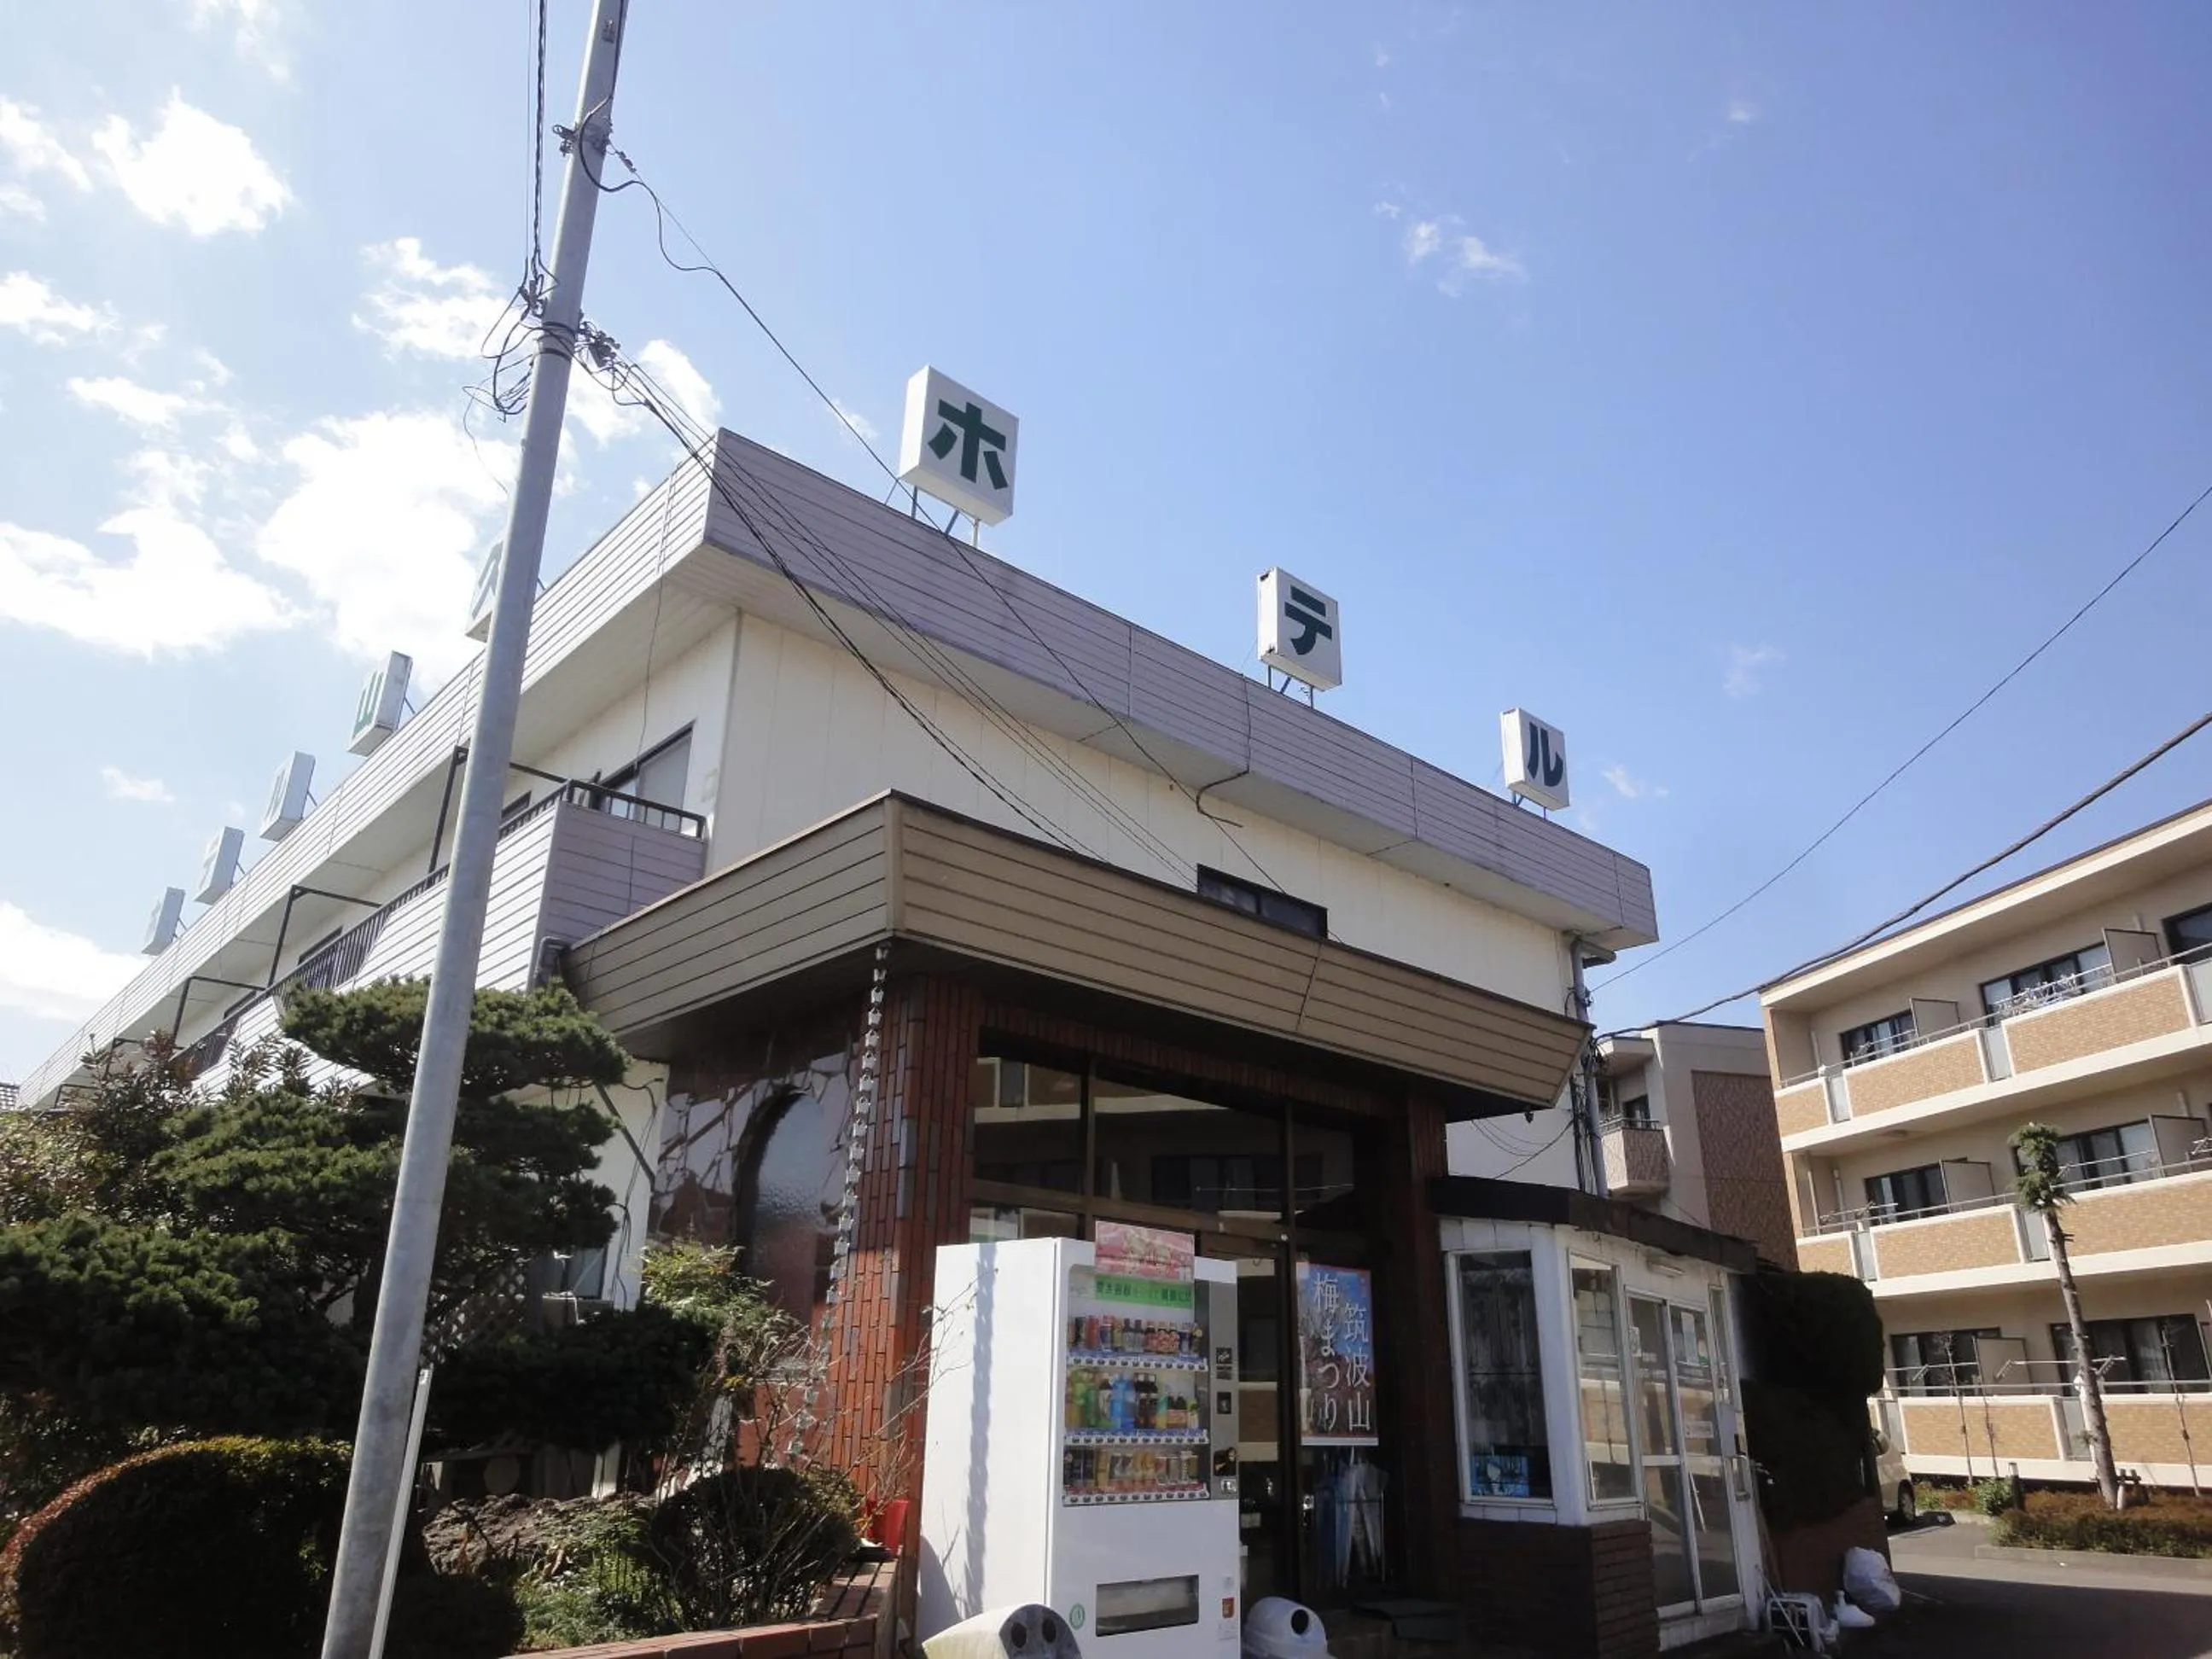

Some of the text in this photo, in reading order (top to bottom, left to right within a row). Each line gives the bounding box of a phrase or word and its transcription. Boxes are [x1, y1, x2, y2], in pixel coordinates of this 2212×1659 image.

[928, 399, 1563, 787] ホ テ ル
[1313, 1272, 1340, 1431] 梅まつり
[1344, 1301, 1371, 1431] 筑波山
